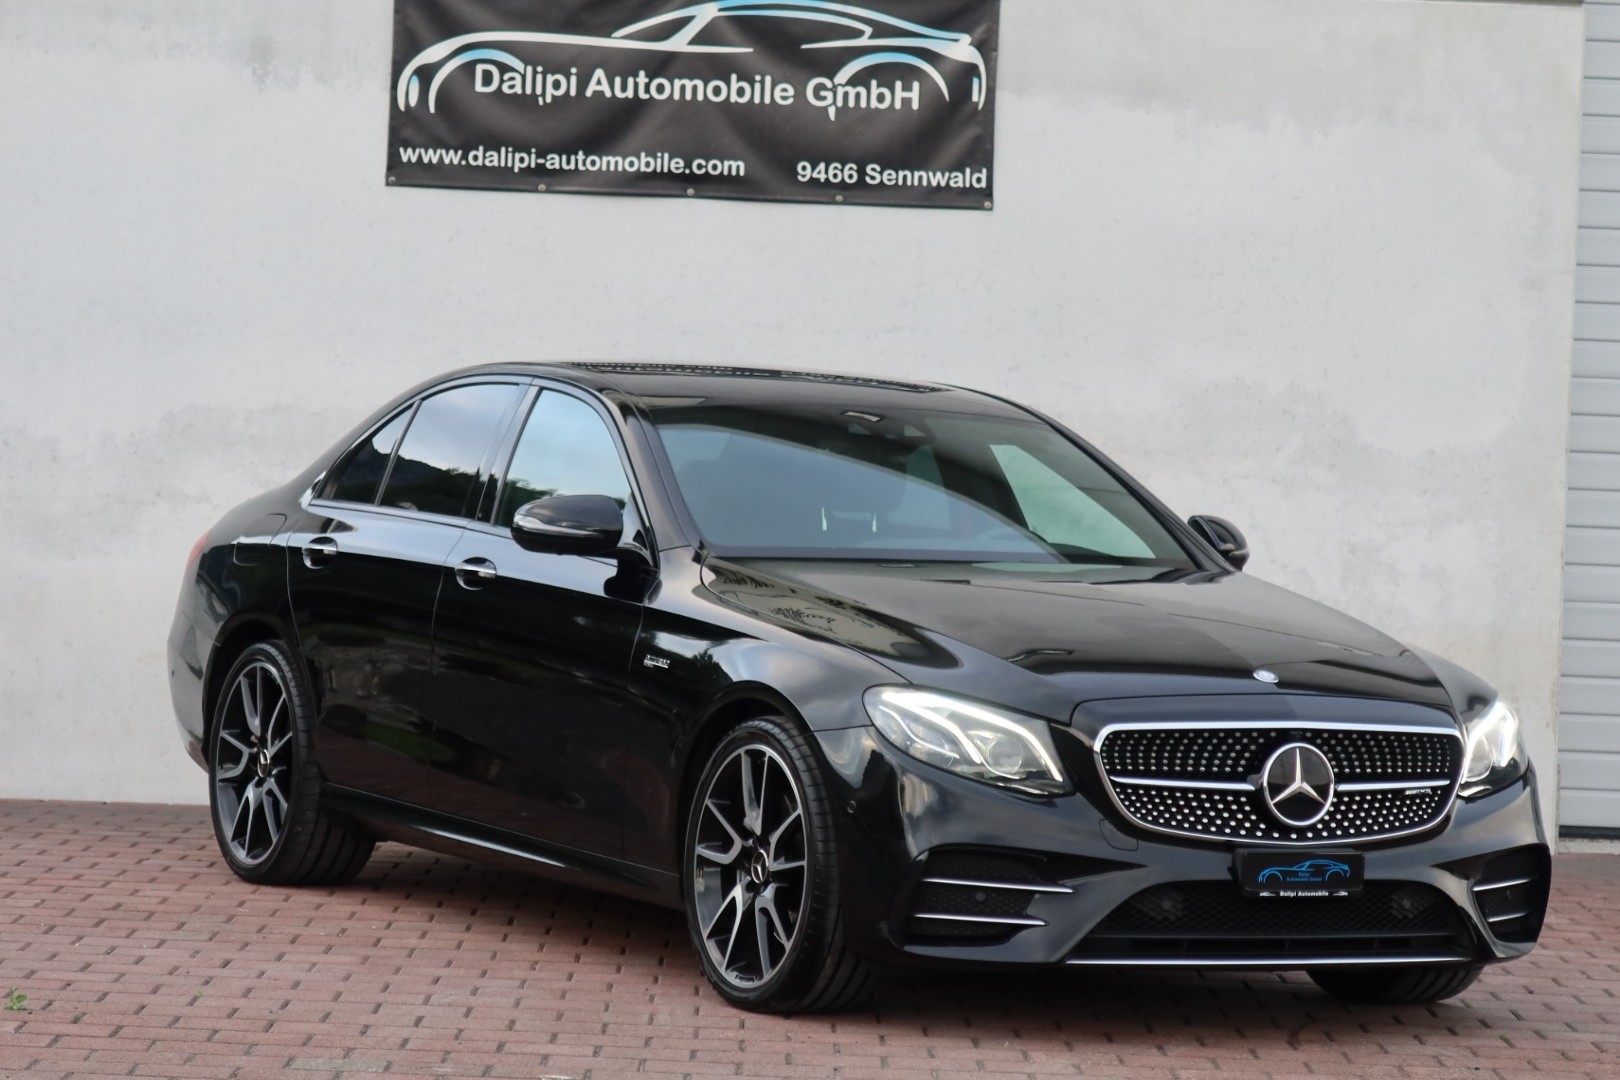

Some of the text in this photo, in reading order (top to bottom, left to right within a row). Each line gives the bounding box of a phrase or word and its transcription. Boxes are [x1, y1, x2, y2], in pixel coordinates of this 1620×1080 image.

[474, 64, 921, 110] Dalipi Automobile GmbH
[399, 146, 746, 176] www.dalipi-automobile.com
[797, 161, 987, 189] 9466 Sennwald
